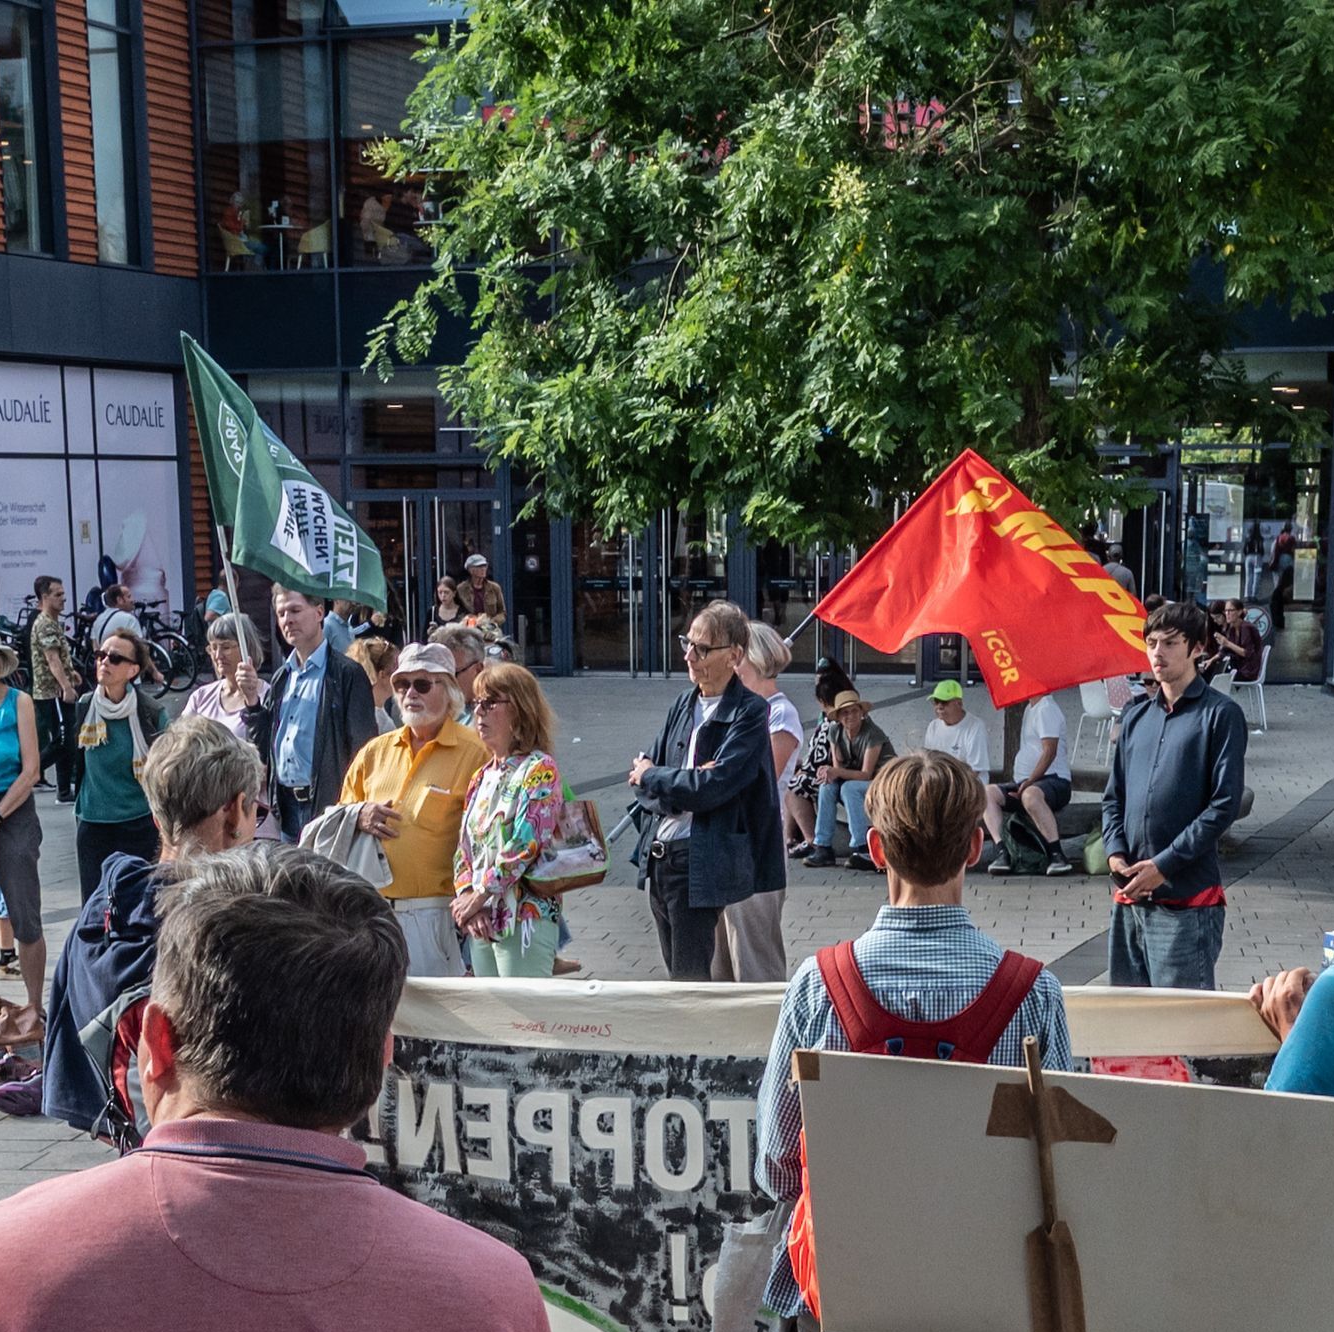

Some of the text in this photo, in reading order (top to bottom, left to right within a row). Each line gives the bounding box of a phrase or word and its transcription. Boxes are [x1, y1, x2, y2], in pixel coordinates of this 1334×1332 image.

[10, 501, 46, 513] Wissenschaft
[990, 510, 1148, 654] MLPD
[980, 629, 1020, 687] ICOR
